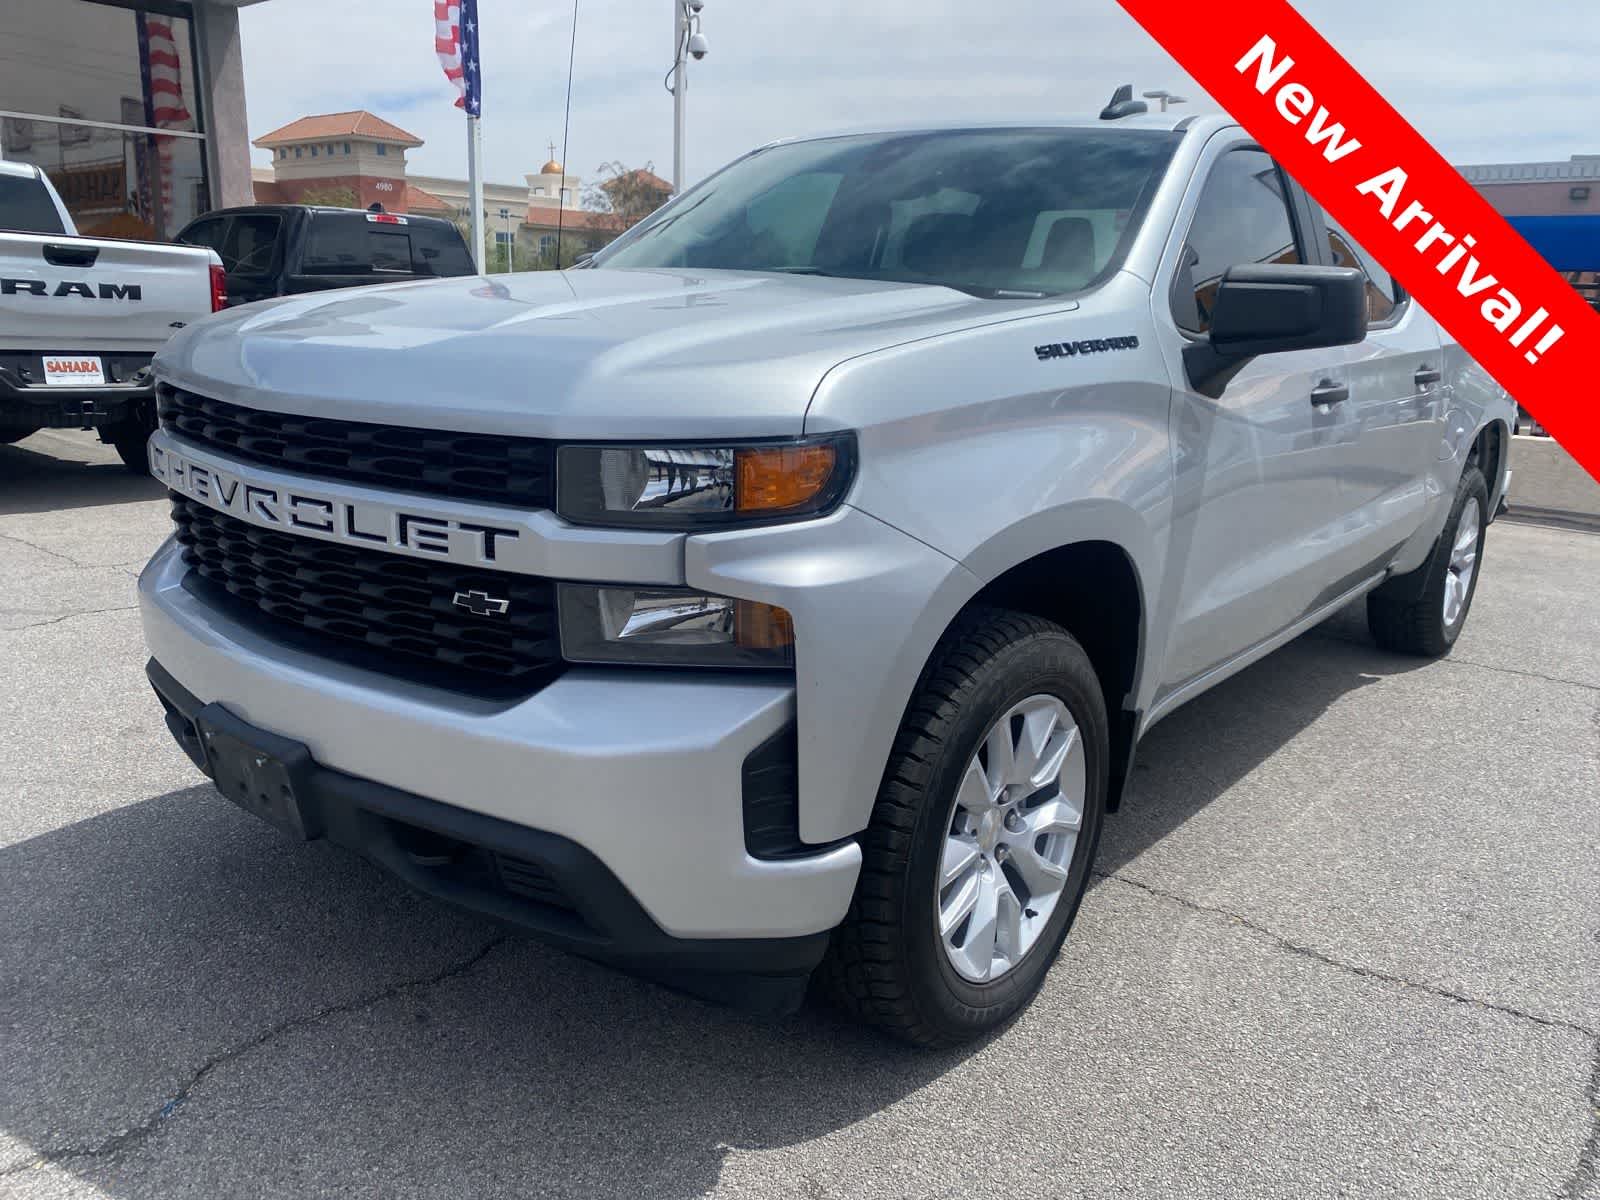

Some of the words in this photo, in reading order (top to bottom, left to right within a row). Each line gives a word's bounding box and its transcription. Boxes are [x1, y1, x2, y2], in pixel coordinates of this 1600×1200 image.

[0, 278, 141, 300] RAM
[1035, 336, 1139, 360] SILVERADO
[47, 361, 99, 373] SAHARA
[150, 447, 519, 562] CHEVROLET
